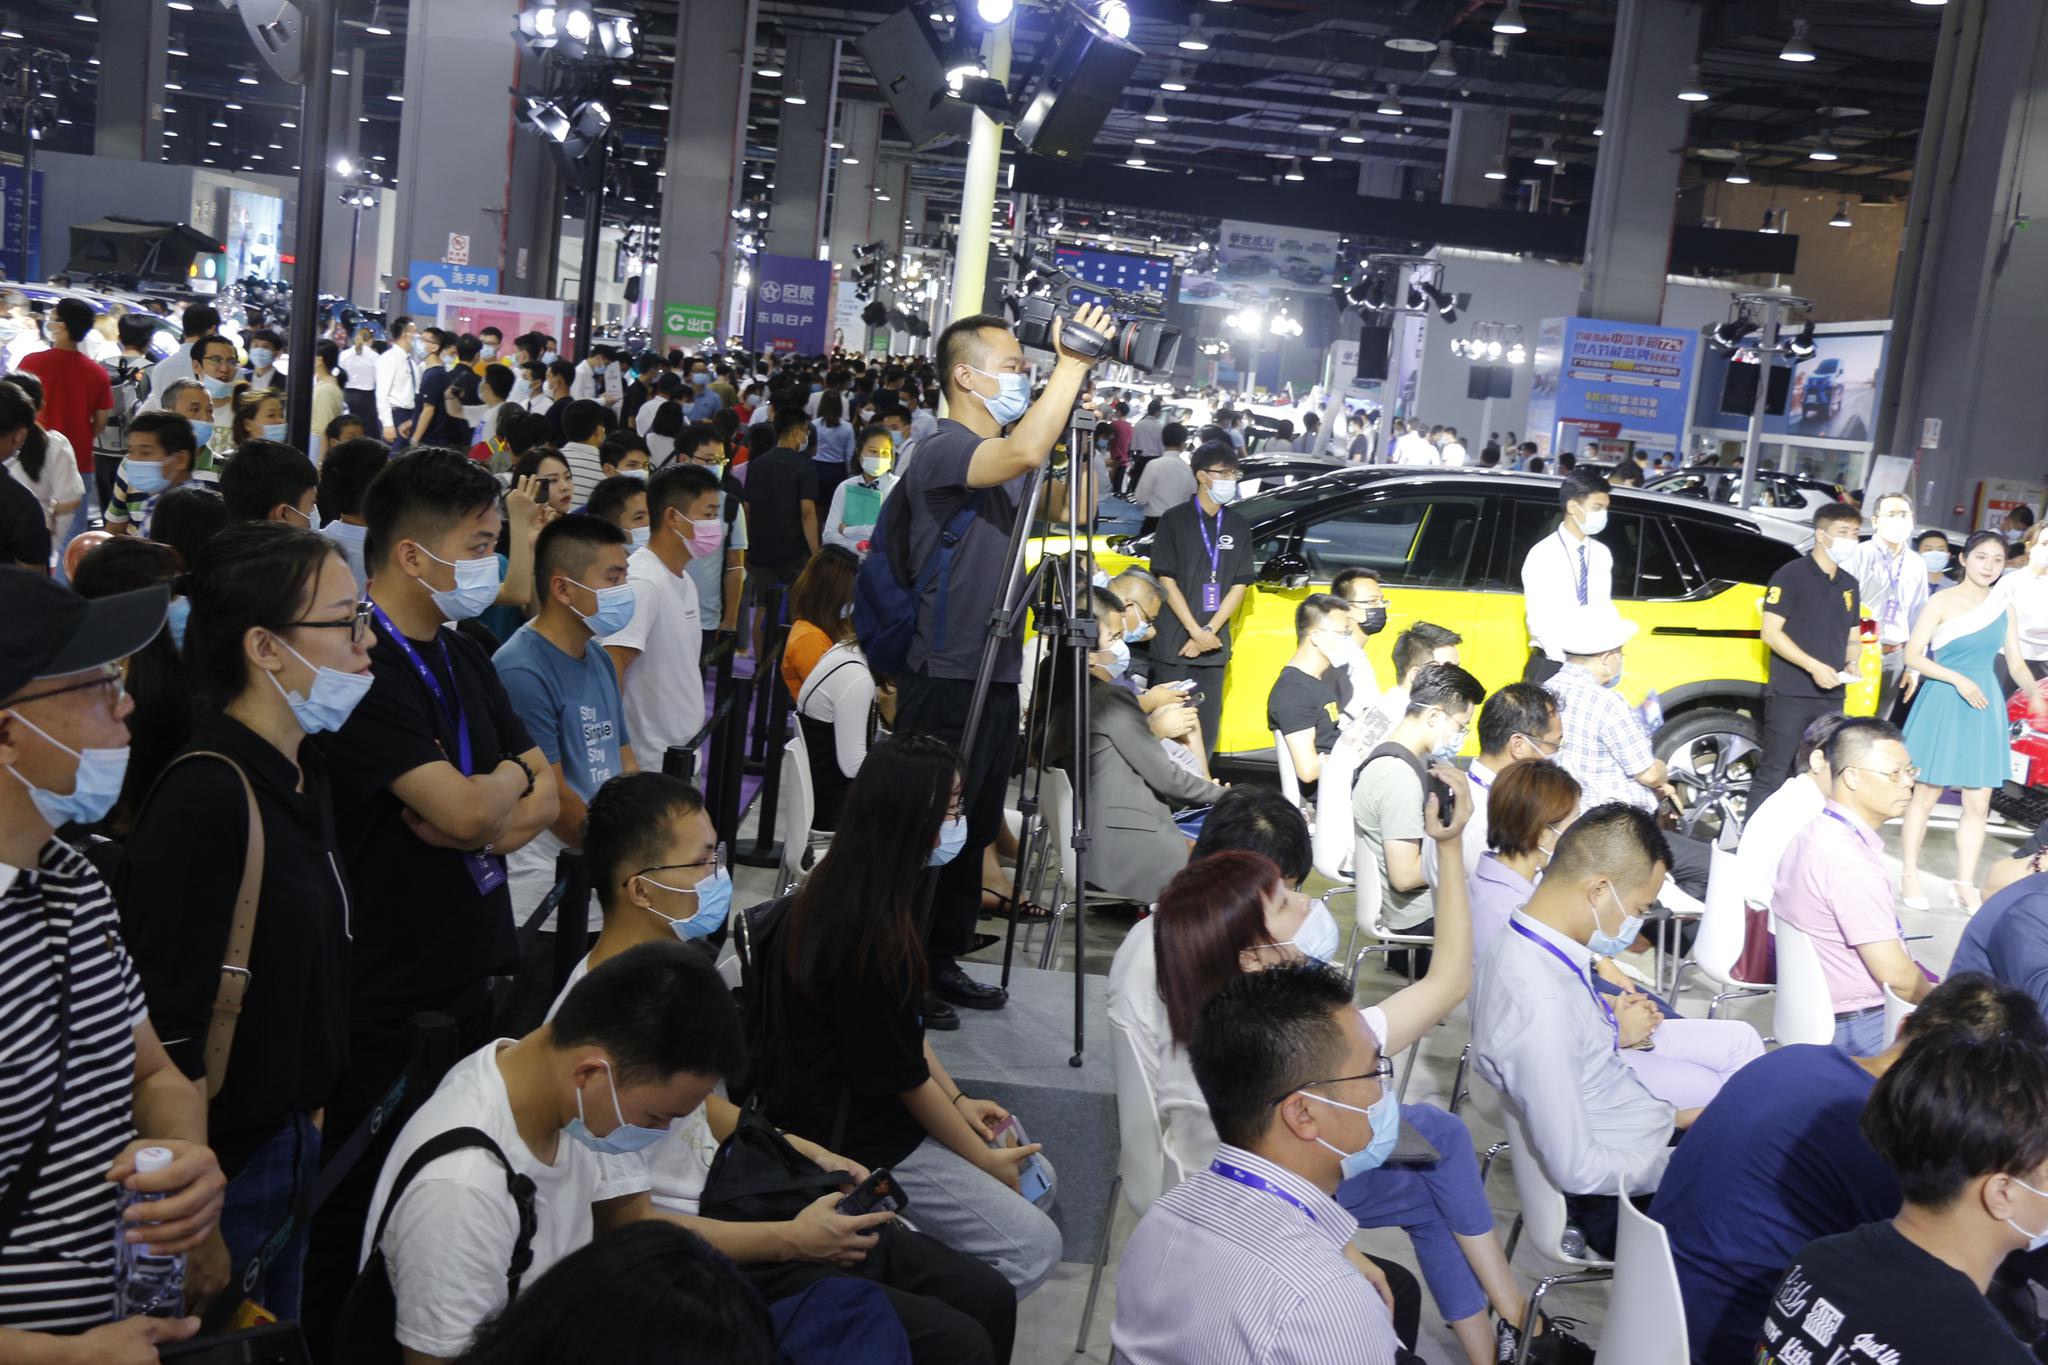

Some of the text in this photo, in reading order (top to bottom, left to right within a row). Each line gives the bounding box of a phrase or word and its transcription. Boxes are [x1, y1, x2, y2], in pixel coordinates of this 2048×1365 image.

[783, 284, 815, 300] 启辰
[687, 317, 714, 333] 出口
[757, 312, 814, 327] 东风日产
